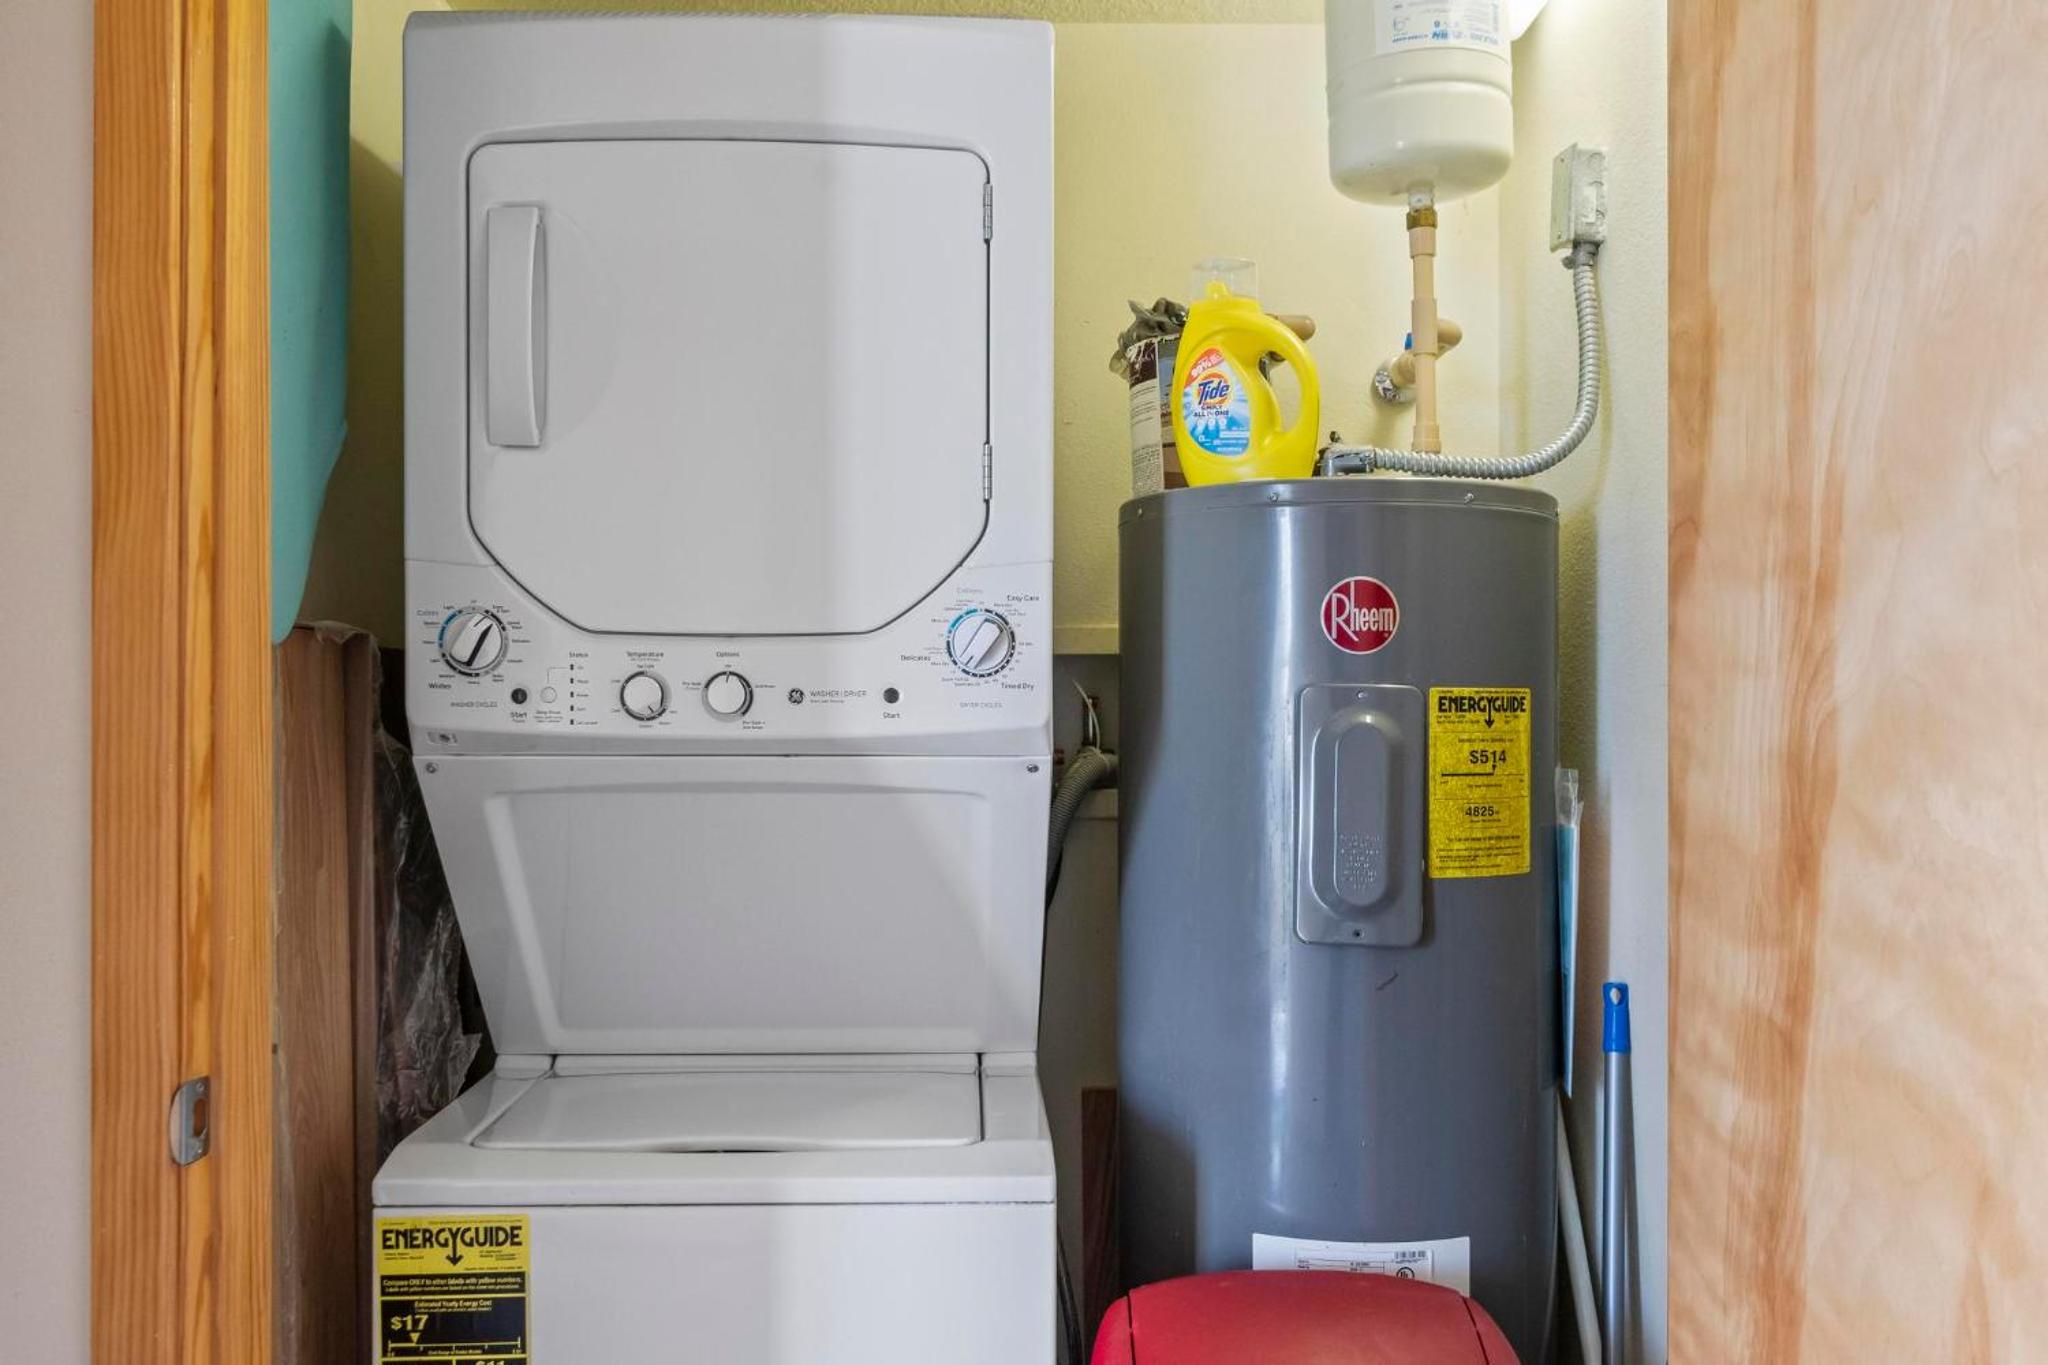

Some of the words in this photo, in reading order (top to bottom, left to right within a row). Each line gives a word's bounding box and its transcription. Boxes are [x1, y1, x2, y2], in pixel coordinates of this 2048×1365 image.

[1199, 379, 1230, 405] Tide
[1332, 580, 1394, 642] Rheem
[626, 651, 664, 659] Temperature
[900, 654, 932, 662] Delicates
[1001, 682, 1021, 690] Timed
[1023, 682, 1035, 691] Dry
[1438, 695, 1526, 713] ENERGYGUIDE
[883, 711, 900, 719] Start
[1465, 806, 1495, 817] 4825
[382, 1225, 523, 1250] ENERGYGUIDE
[390, 1314, 429, 1331] $17
